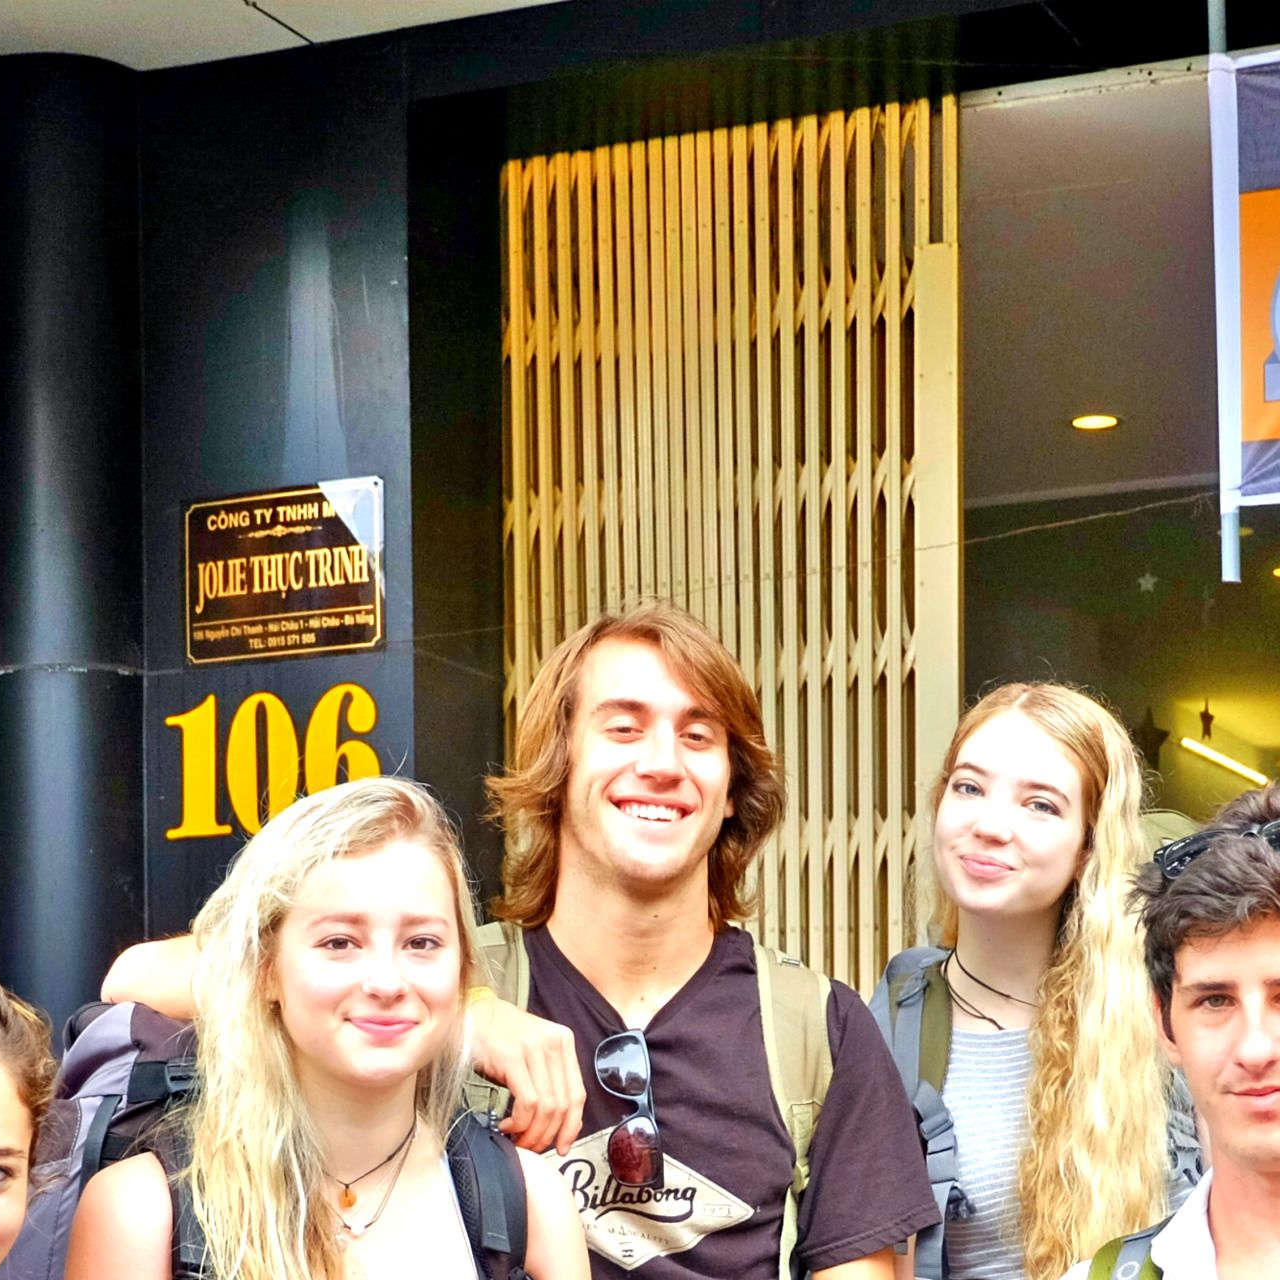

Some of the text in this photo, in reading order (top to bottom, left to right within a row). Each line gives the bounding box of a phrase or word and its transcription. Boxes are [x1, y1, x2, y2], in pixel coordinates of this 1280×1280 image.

[206, 510, 251, 532] CÔNG
[253, 507, 274, 525] TY
[276, 501, 319, 522] TNHH
[195, 544, 370, 614] JOLIE THỤC TRINH
[249, 638, 267, 650] TEL:
[165, 683, 381, 840] 106
[558, 1158, 698, 1224] Billabong
